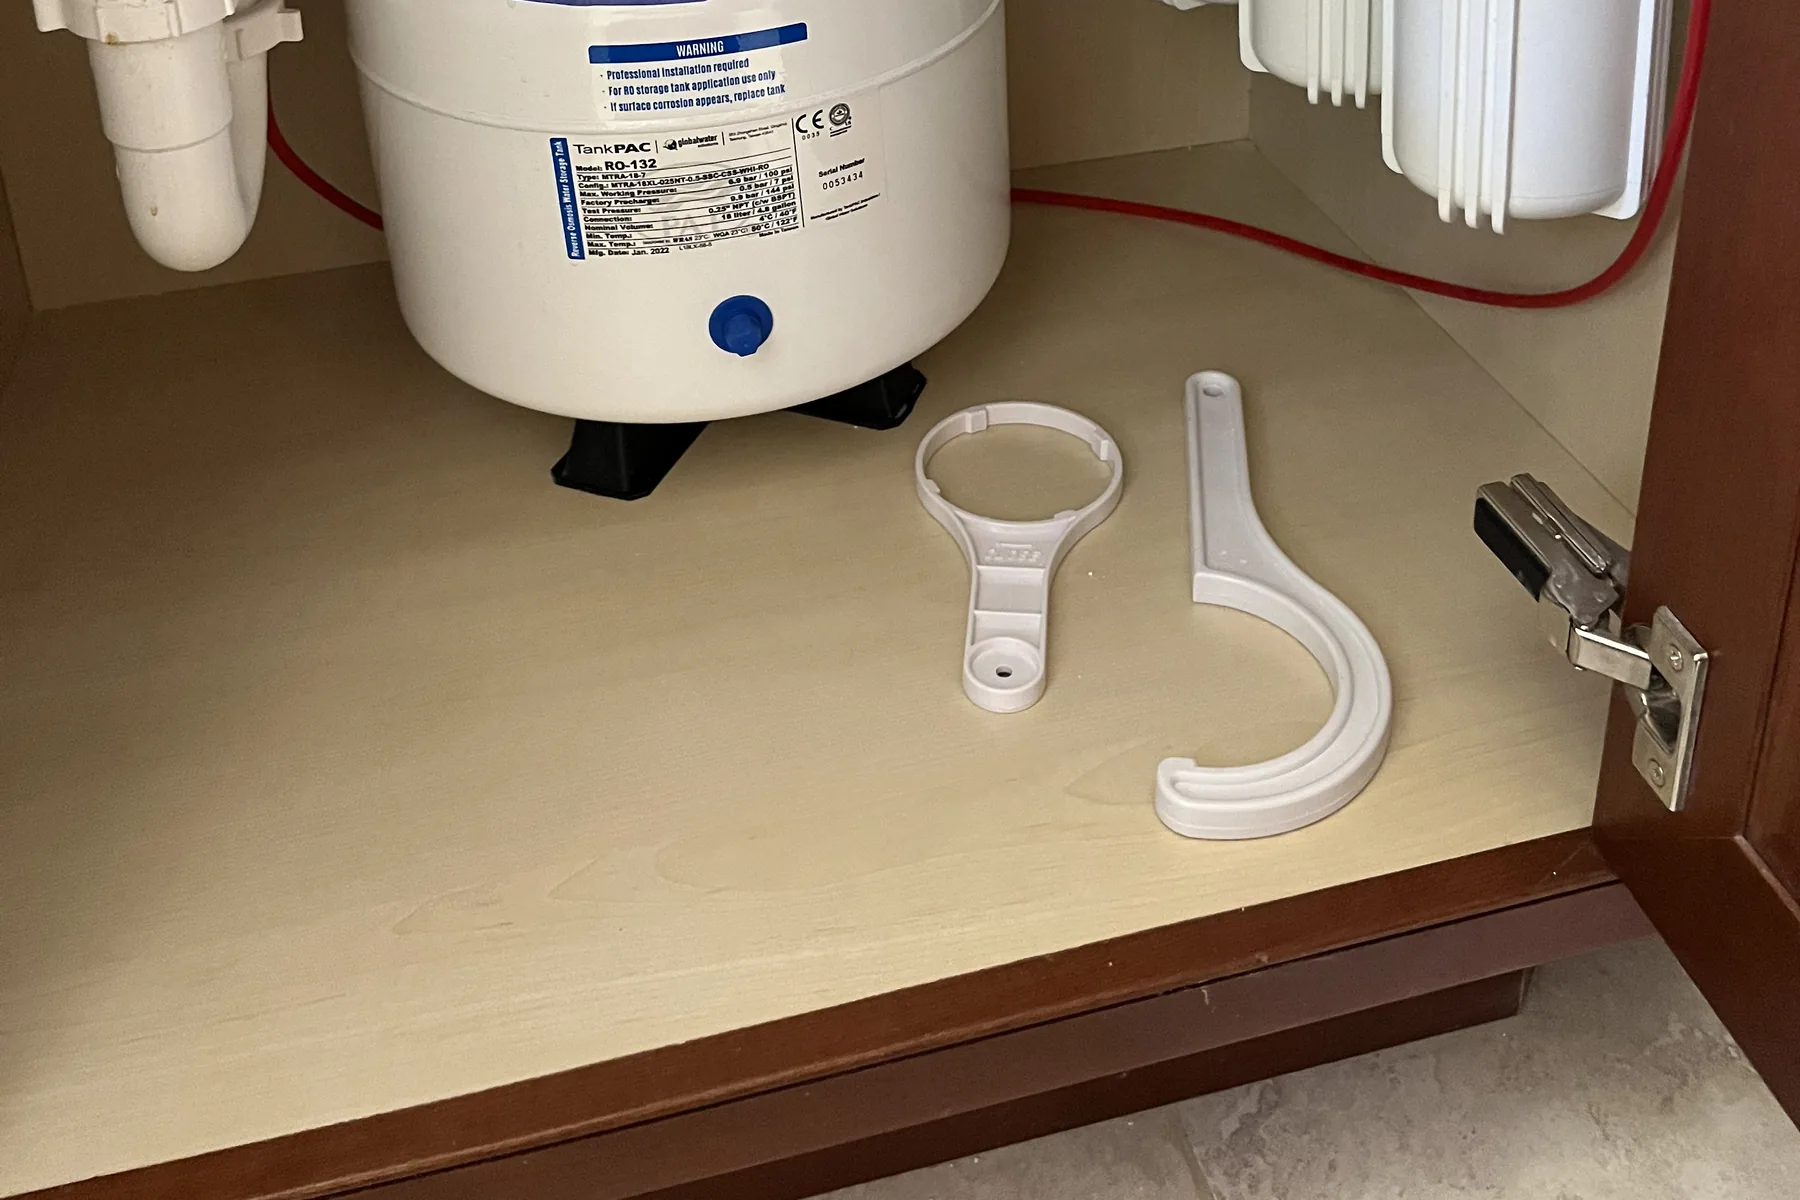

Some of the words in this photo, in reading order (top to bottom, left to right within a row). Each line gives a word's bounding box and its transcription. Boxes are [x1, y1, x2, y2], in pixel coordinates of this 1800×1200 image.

[676, 40, 724, 58] WARNING
[606, 68, 661, 81] Professional
[662, 63, 712, 78] Installation
[713, 57, 750, 74] required
[608, 86, 622, 96] For
[623, 85, 635, 96] RO
[636, 83, 669, 96] storage
[671, 81, 691, 93] tank
[692, 75, 740, 92] application
[742, 73, 757, 84] use
[758, 69, 777, 82] only
[610, 101, 617, 112] If
[619, 100, 651, 112] surface
[653, 97, 694, 110] corrosion
[695, 93, 733, 108] appears,
[734, 87, 766, 103] replace
[767, 83, 786, 97] tank
[677, 134, 718, 148] globalwater
[801, 131, 820, 141] 0035
[554, 140, 565, 157] Tank
[572, 142, 651, 155] TankPAC
[558, 157, 568, 184] Storage
[604, 158, 657, 171] RO-132
[818, 166, 839, 178] Serial
[839, 158, 865, 172] Number
[601, 172, 646, 180] MTRA-18-7
[601, 189, 635, 198] Working
[637, 187, 678, 196] Pressure:
[764, 169, 779, 178] 100
[781, 166, 793, 177] psi
[822, 170, 864, 191] 0053434
[562, 184, 571, 204] Water
[578, 182, 609, 190] Config.:
[580, 199, 613, 207] Factory
[614, 197, 660, 207] Precharge:
[782, 175, 794, 185] psi
[782, 183, 795, 193] psi
[721, 213, 732, 221] 18
[733, 210, 751, 219] liter
[772, 200, 797, 212] gallon
[732, 201, 750, 210] NPT
[564, 204, 576, 231] Osmosis
[570, 232, 580, 258] Reverse
[588, 249, 606, 257] Mfg.
[607, 248, 630, 256] Date:
[650, 247, 670, 255] 2022
[608, 240, 636, 248] Temp.:
